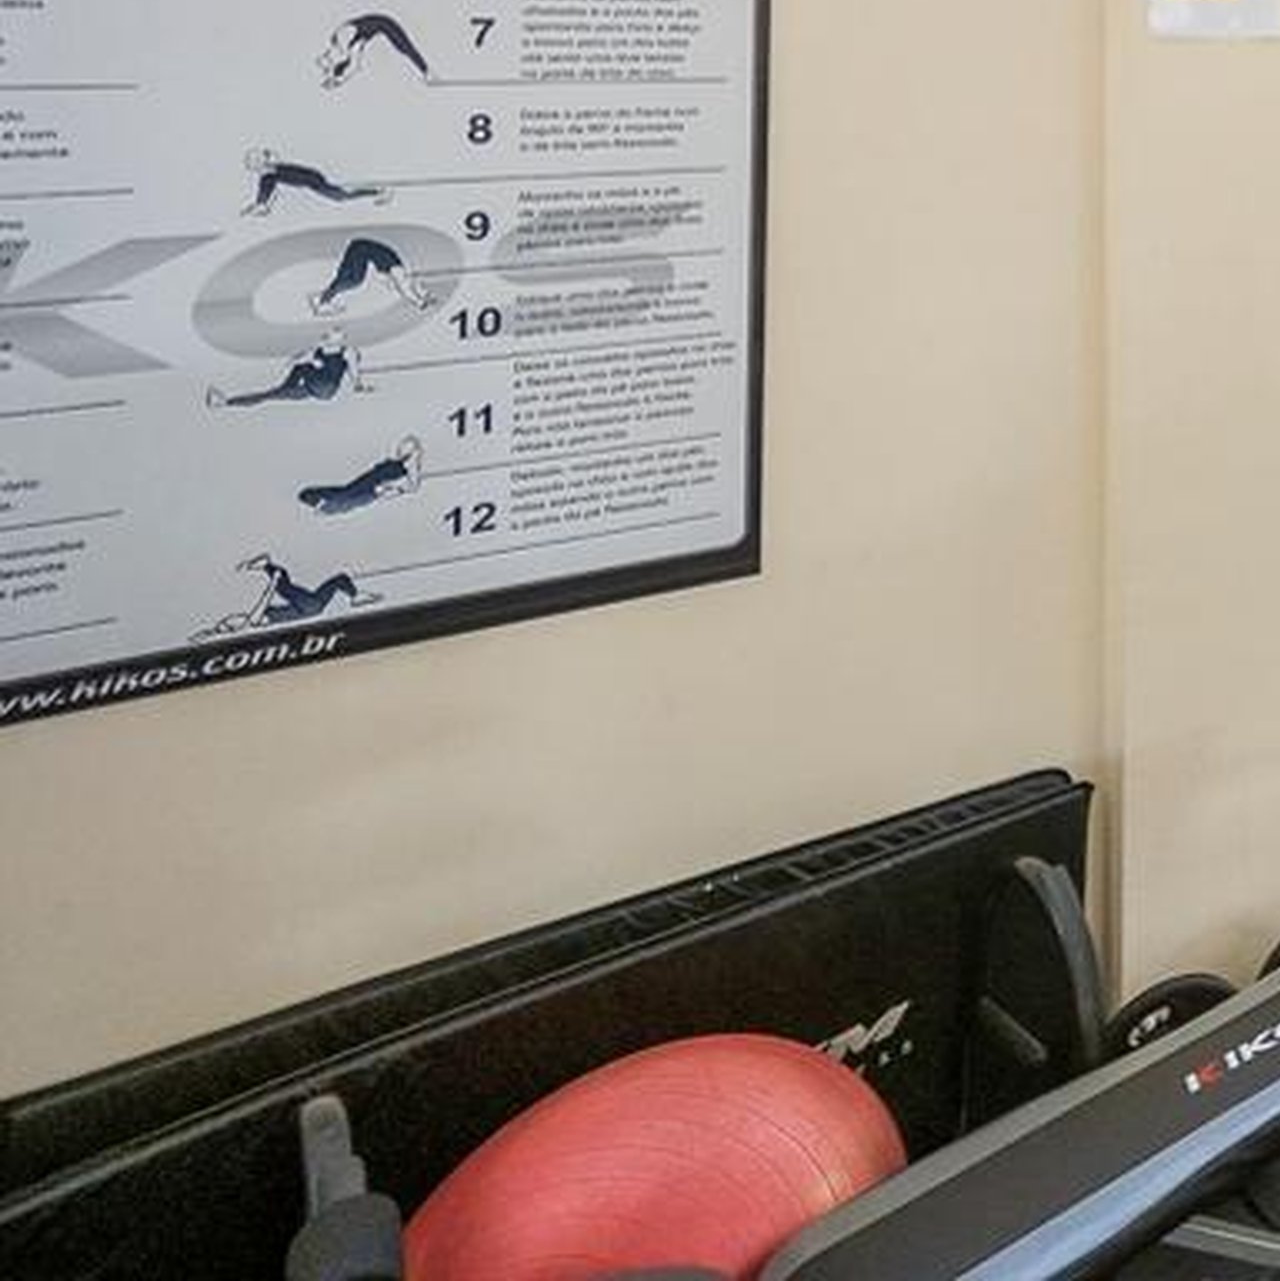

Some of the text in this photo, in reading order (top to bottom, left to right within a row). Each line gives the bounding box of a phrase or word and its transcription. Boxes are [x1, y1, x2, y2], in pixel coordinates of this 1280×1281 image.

[470, 18, 496, 48] 7
[467, 114, 493, 144] 8
[465, 211, 490, 241] 9
[450, 306, 502, 339] 10
[449, 403, 492, 437] 11
[444, 502, 497, 537] 12
